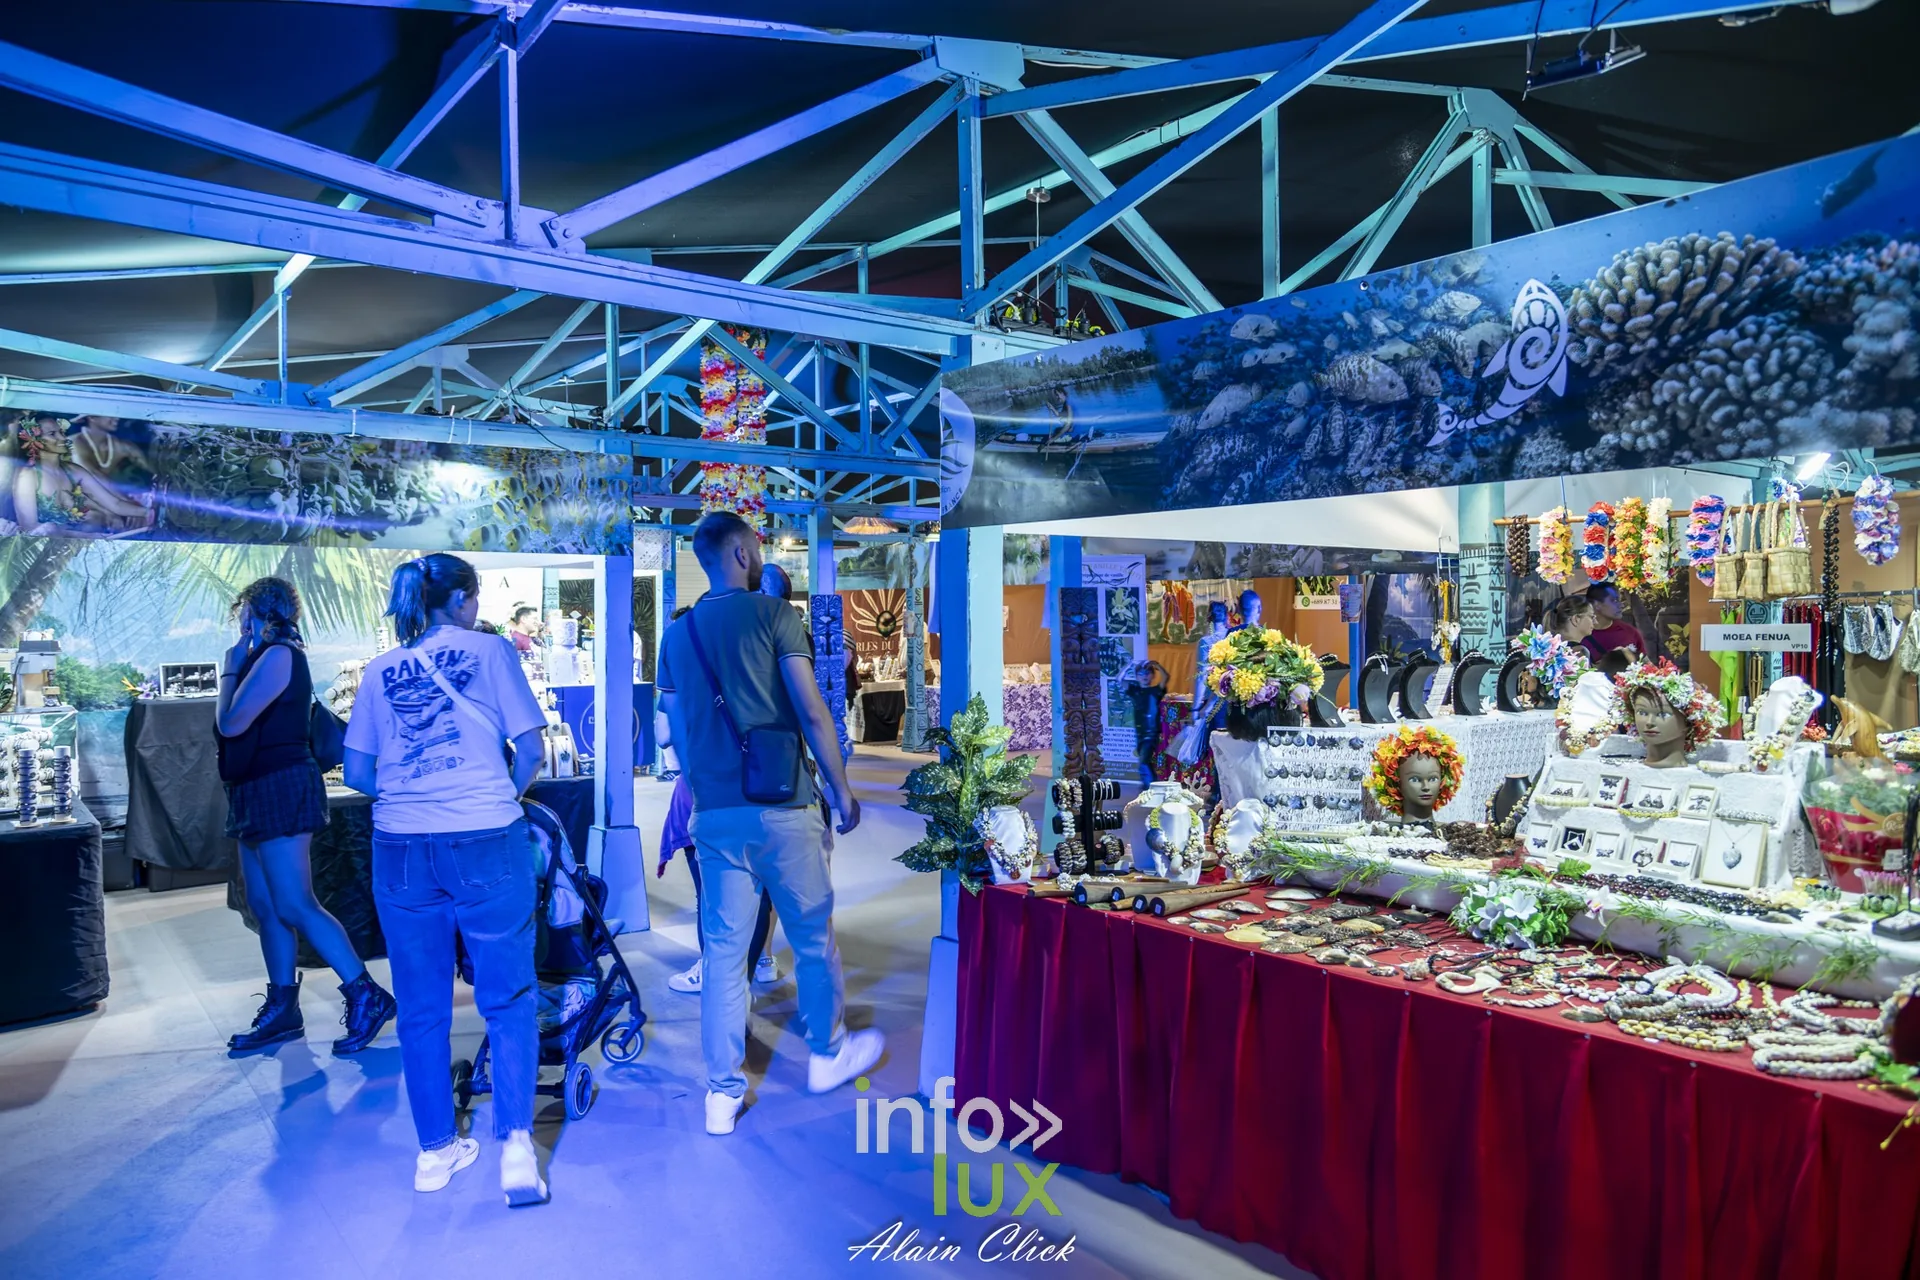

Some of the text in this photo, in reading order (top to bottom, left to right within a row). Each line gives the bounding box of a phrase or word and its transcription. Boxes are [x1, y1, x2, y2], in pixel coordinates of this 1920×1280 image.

[1722, 633, 1791, 641] MOEA FENUA
[855, 640, 895, 652] RLES DU
